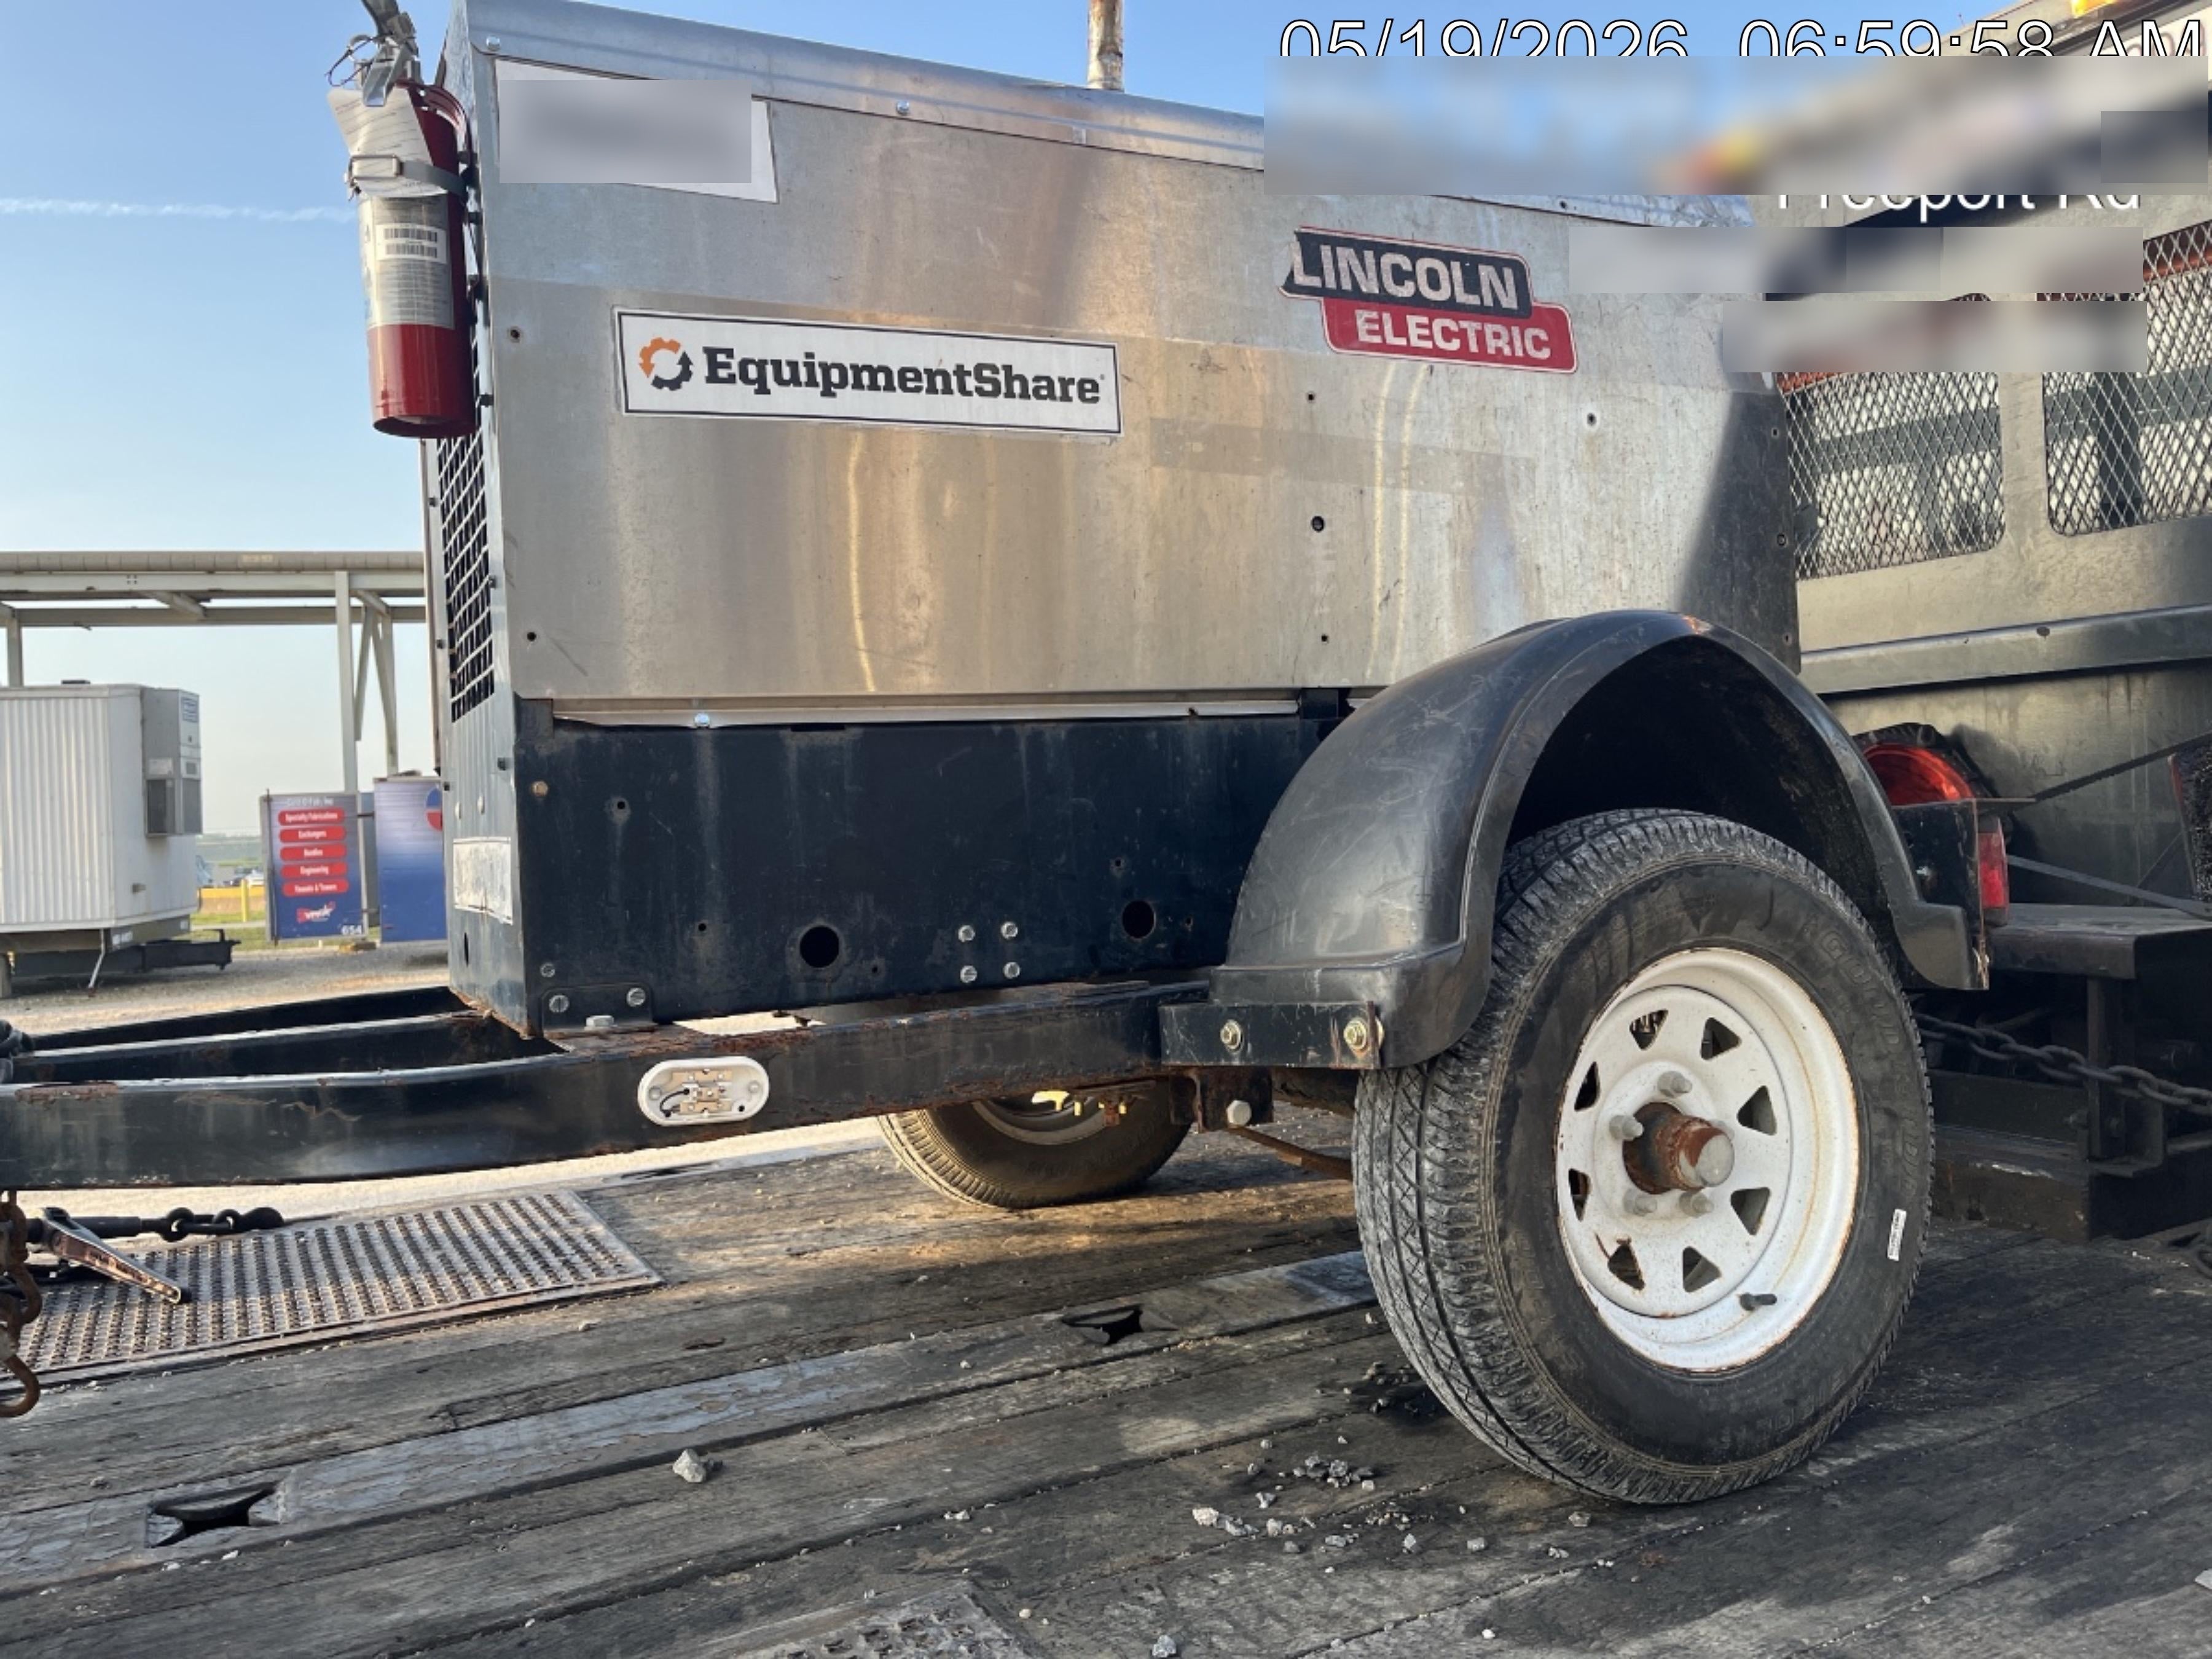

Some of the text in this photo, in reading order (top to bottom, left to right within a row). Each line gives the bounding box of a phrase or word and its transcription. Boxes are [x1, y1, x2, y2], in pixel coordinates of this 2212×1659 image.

[1291, 236, 1518, 309] LINCOLN
[1354, 309, 1551, 360] ELECTRIC
[702, 346, 1102, 404] EquipmentShare
